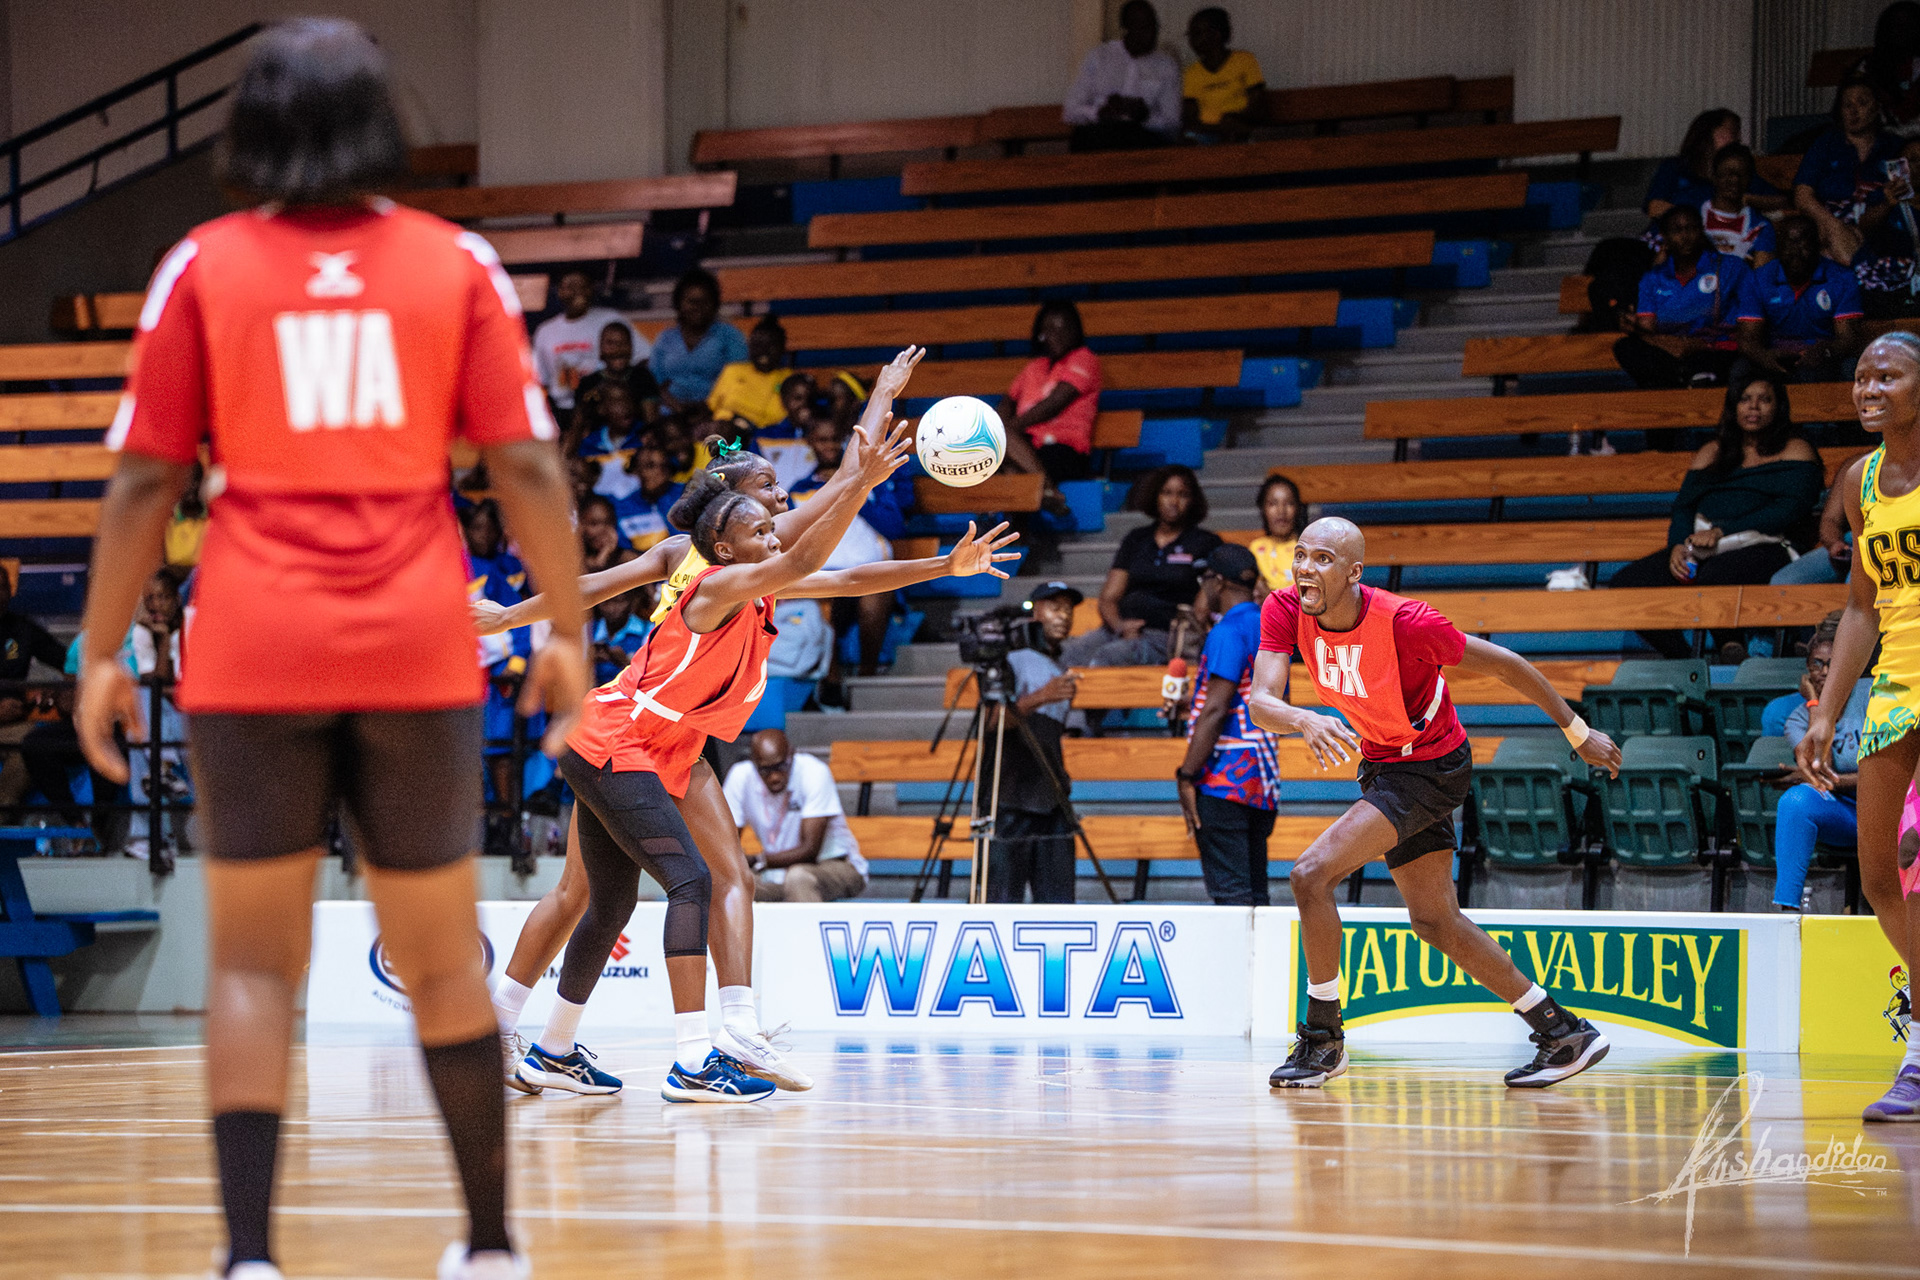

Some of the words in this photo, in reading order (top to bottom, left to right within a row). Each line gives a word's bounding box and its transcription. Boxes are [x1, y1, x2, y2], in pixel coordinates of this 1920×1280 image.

[272, 309, 408, 432] WA
[929, 457, 994, 477] GILBERT
[1866, 526, 1920, 590] GS
[1314, 636, 1369, 699] GK
[601, 966, 649, 978] UZUKI
[1522, 930, 1723, 1031] VALLEY
